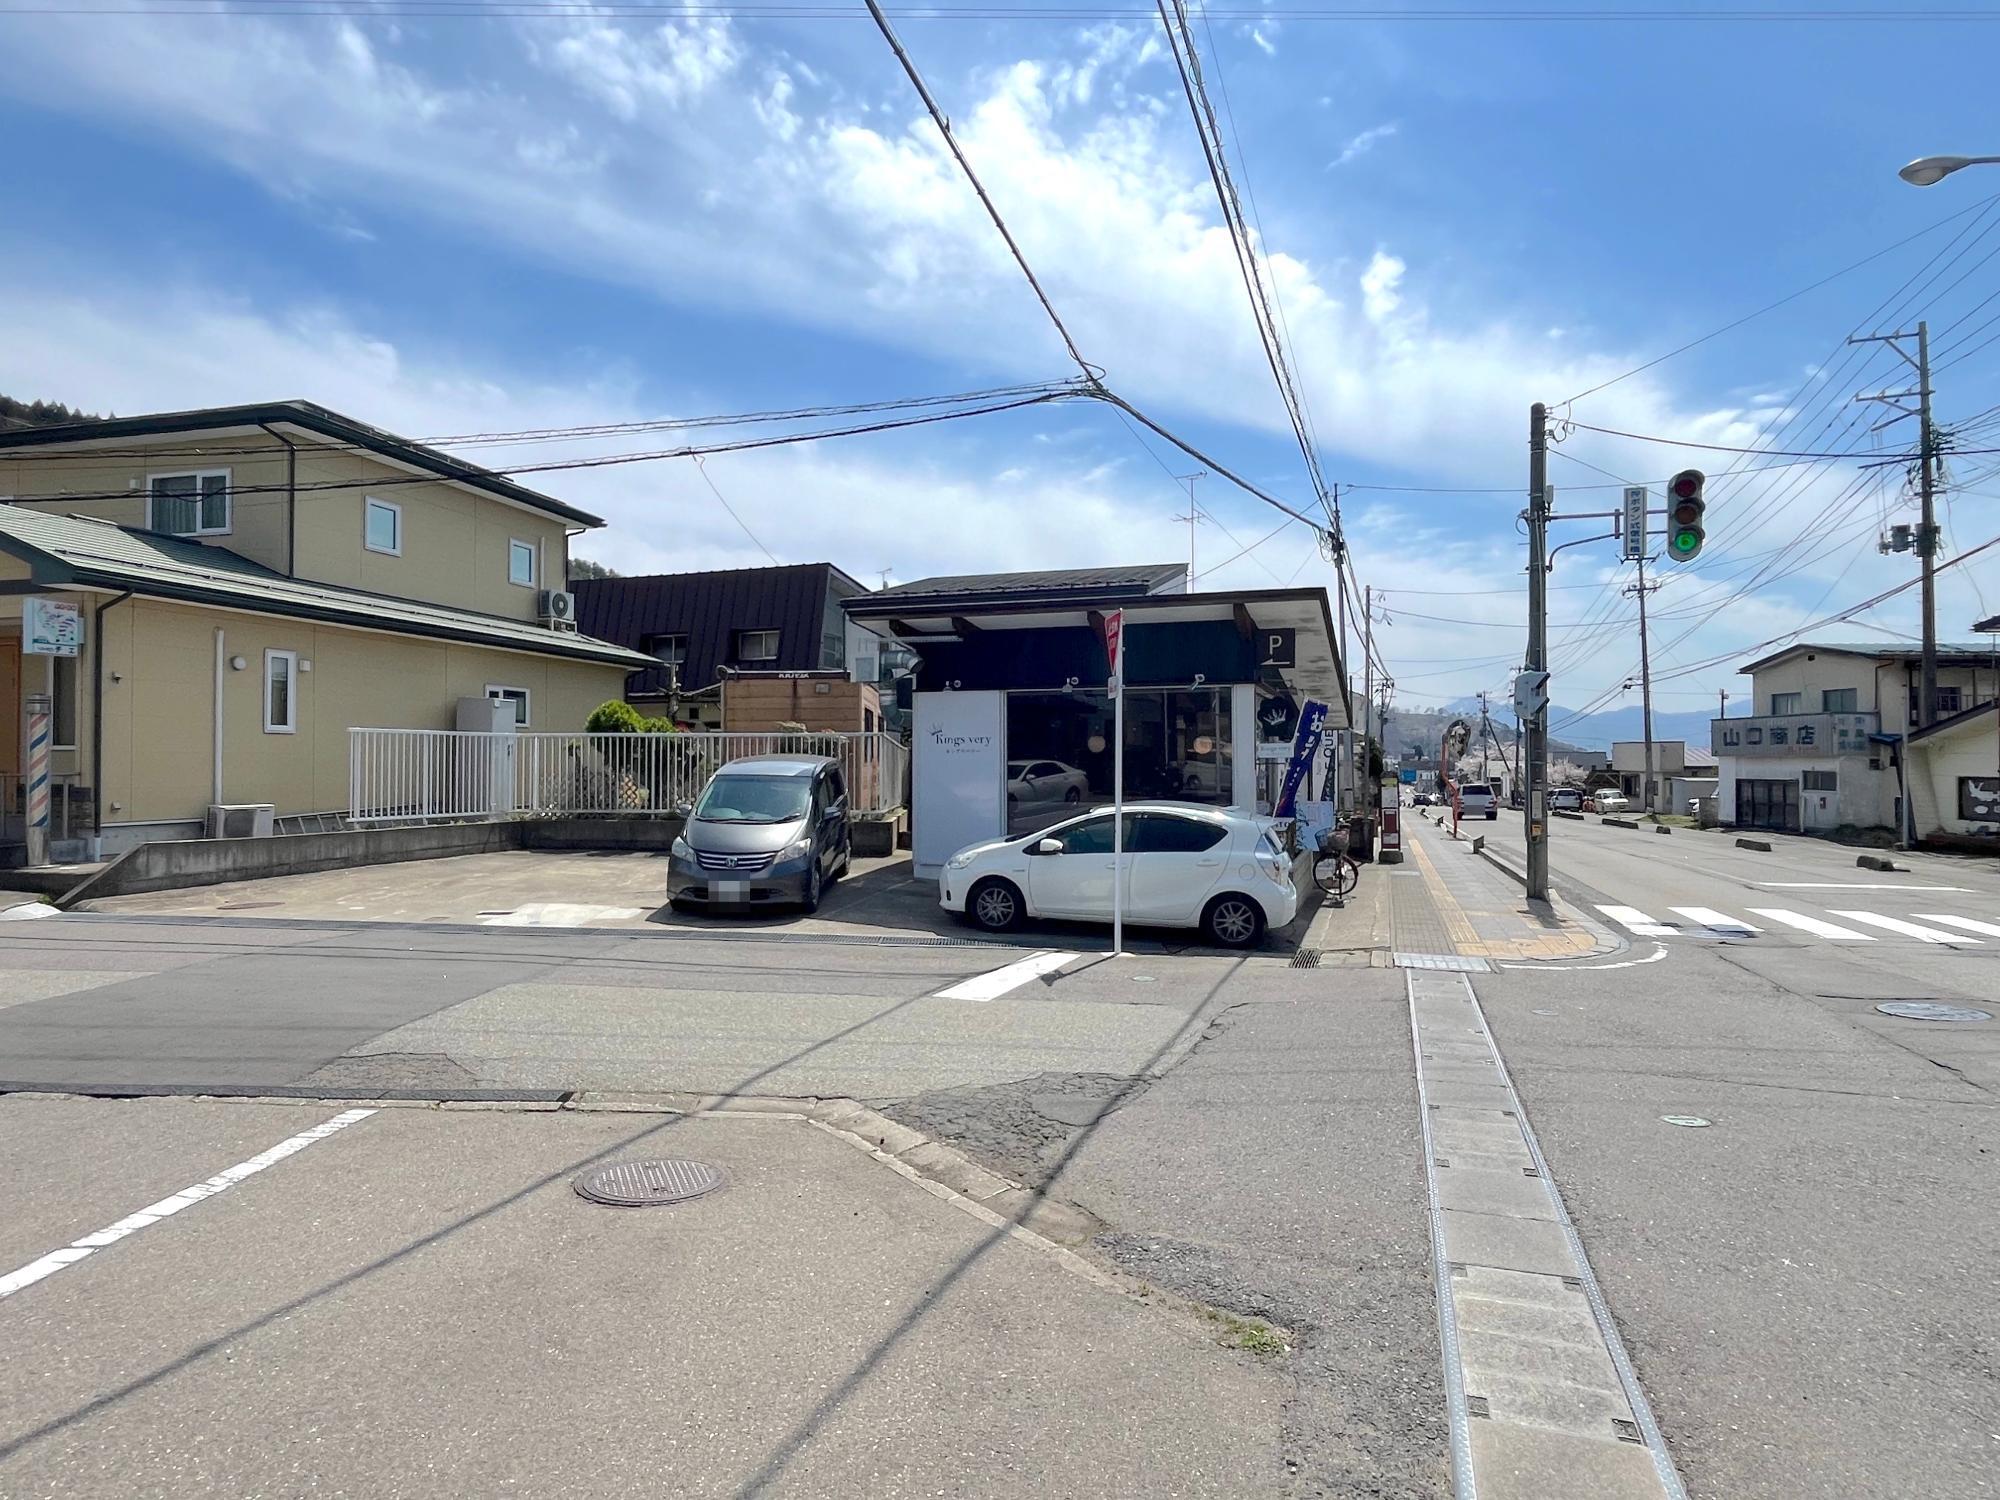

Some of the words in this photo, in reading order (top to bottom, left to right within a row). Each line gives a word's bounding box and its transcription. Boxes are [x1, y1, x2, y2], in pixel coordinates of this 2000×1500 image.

[1269, 635, 1283, 655] P
[936, 734, 966, 747] Kings
[969, 736, 992, 747] very
[1722, 724, 1816, 747] 山口商店
